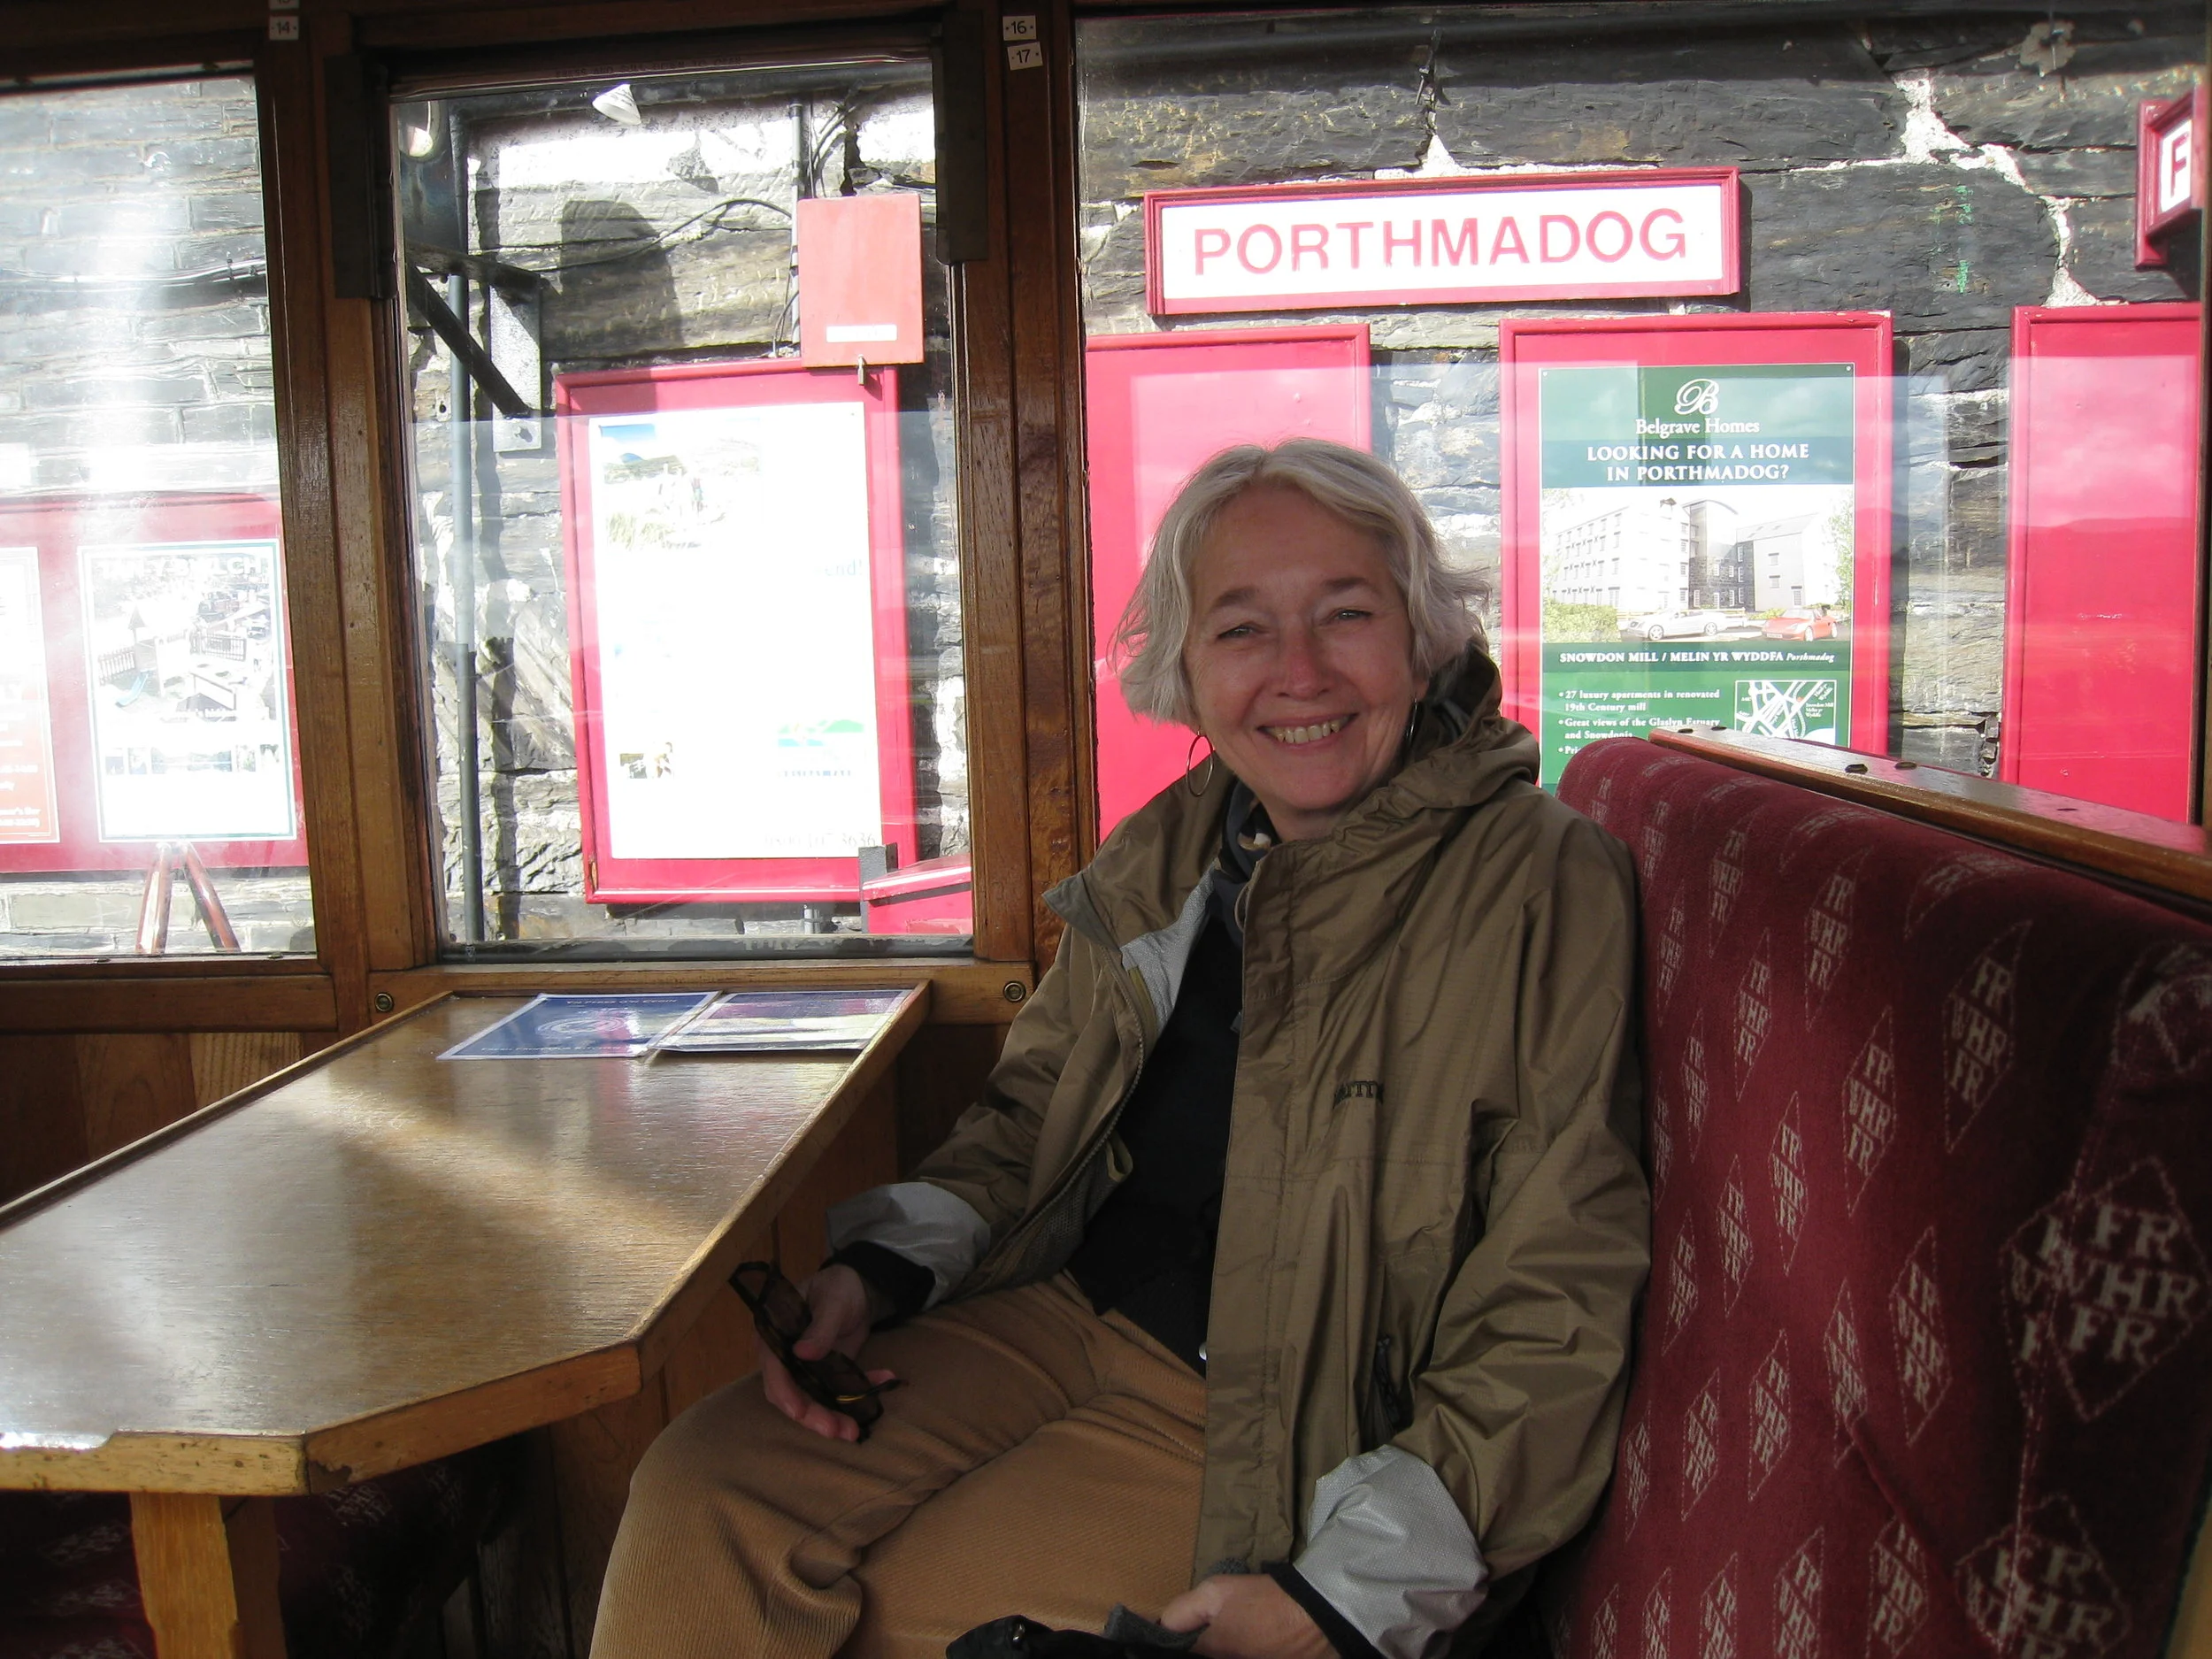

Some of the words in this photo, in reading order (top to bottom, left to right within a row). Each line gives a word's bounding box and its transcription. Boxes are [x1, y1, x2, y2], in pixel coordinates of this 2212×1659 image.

[277, 21, 290, 35] 14
[1011, 21, 1026, 34] 16
[1017, 50, 1031, 63] 17
[1194, 207, 1686, 277] PORTHMADOG
[1636, 419, 1701, 439] Belgrave
[1704, 419, 1760, 434] Homes
[1587, 443, 1680, 462] LOOKING
[1686, 444, 1726, 460] FOR
[1731, 445, 1744, 459] A
[1750, 443, 1809, 459] HOME
[1607, 466, 1630, 481] IN
[1637, 465, 1790, 481] PORTHMADOG?
[1559, 652, 1624, 663] SNOWDON
[1628, 652, 1659, 663] MILL
[1662, 652, 1667, 663] /
[1670, 651, 1709, 662] MELIN
[1712, 651, 1729, 662] YR
[1732, 651, 1785, 662] WYDDFA
[1786, 652, 1835, 663] Porthmadog
[1565, 703, 1585, 711] 19th
[1588, 703, 1625, 713] Century
[1628, 703, 1646, 711] mill
[1579, 690, 1609, 701] luxury
[1611, 691, 1661, 701] apartments
[1676, 689, 1720, 698] renovated
[1564, 718, 1589, 726] Great
[1619, 718, 1630, 726] of
[1649, 718, 1682, 726] Glaslyn
[1750, 958, 1770, 996] FR
[1970, 956, 2010, 1016] FR
[1737, 1026, 1756, 1065] FR
[1863, 1043, 1893, 1094] FR
[1948, 1047, 1985, 1115] FR
[1780, 1123, 1803, 1169] FR
[1847, 1122, 1874, 1178] FR
[1775, 1195, 1798, 1240] FR
[2085, 1202, 2180, 1262] FR
[1908, 1259, 1940, 1329] FR
[2066, 1301, 2157, 1368] FR
[1770, 1356, 1788, 1403] FR
[1904, 1345, 1931, 1416] FR
[1700, 1391, 1717, 1432] FR
[1753, 1423, 1774, 1466] FR
[1685, 1452, 1703, 1494] FR
[1716, 1576, 1735, 1626] FR
[1794, 1555, 1821, 1610] FR
